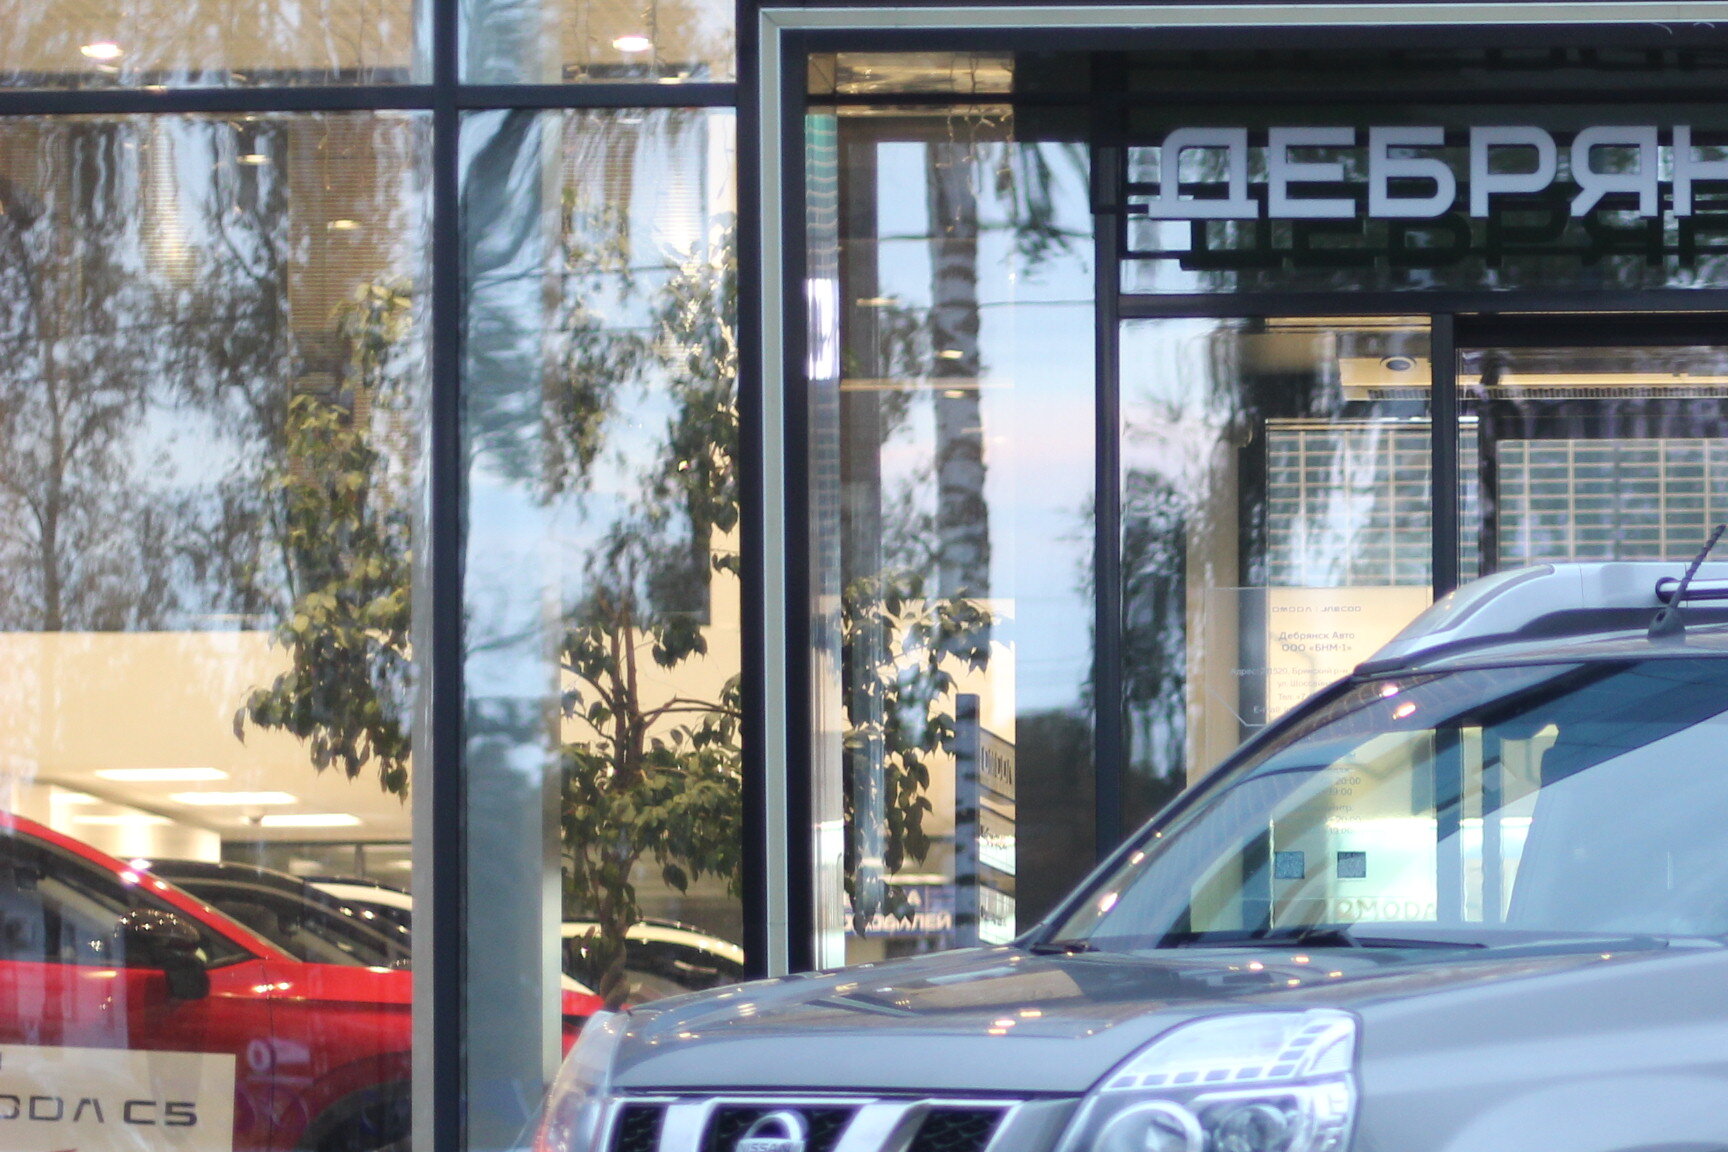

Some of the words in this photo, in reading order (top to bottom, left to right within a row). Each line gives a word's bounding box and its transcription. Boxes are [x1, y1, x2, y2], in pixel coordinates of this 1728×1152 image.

[1278, 631, 1329, 642] Дебрянск
[1332, 632, 1355, 640] Авто
[1281, 643, 1306, 652] ООО
[123, 1100, 198, 1127] C5
